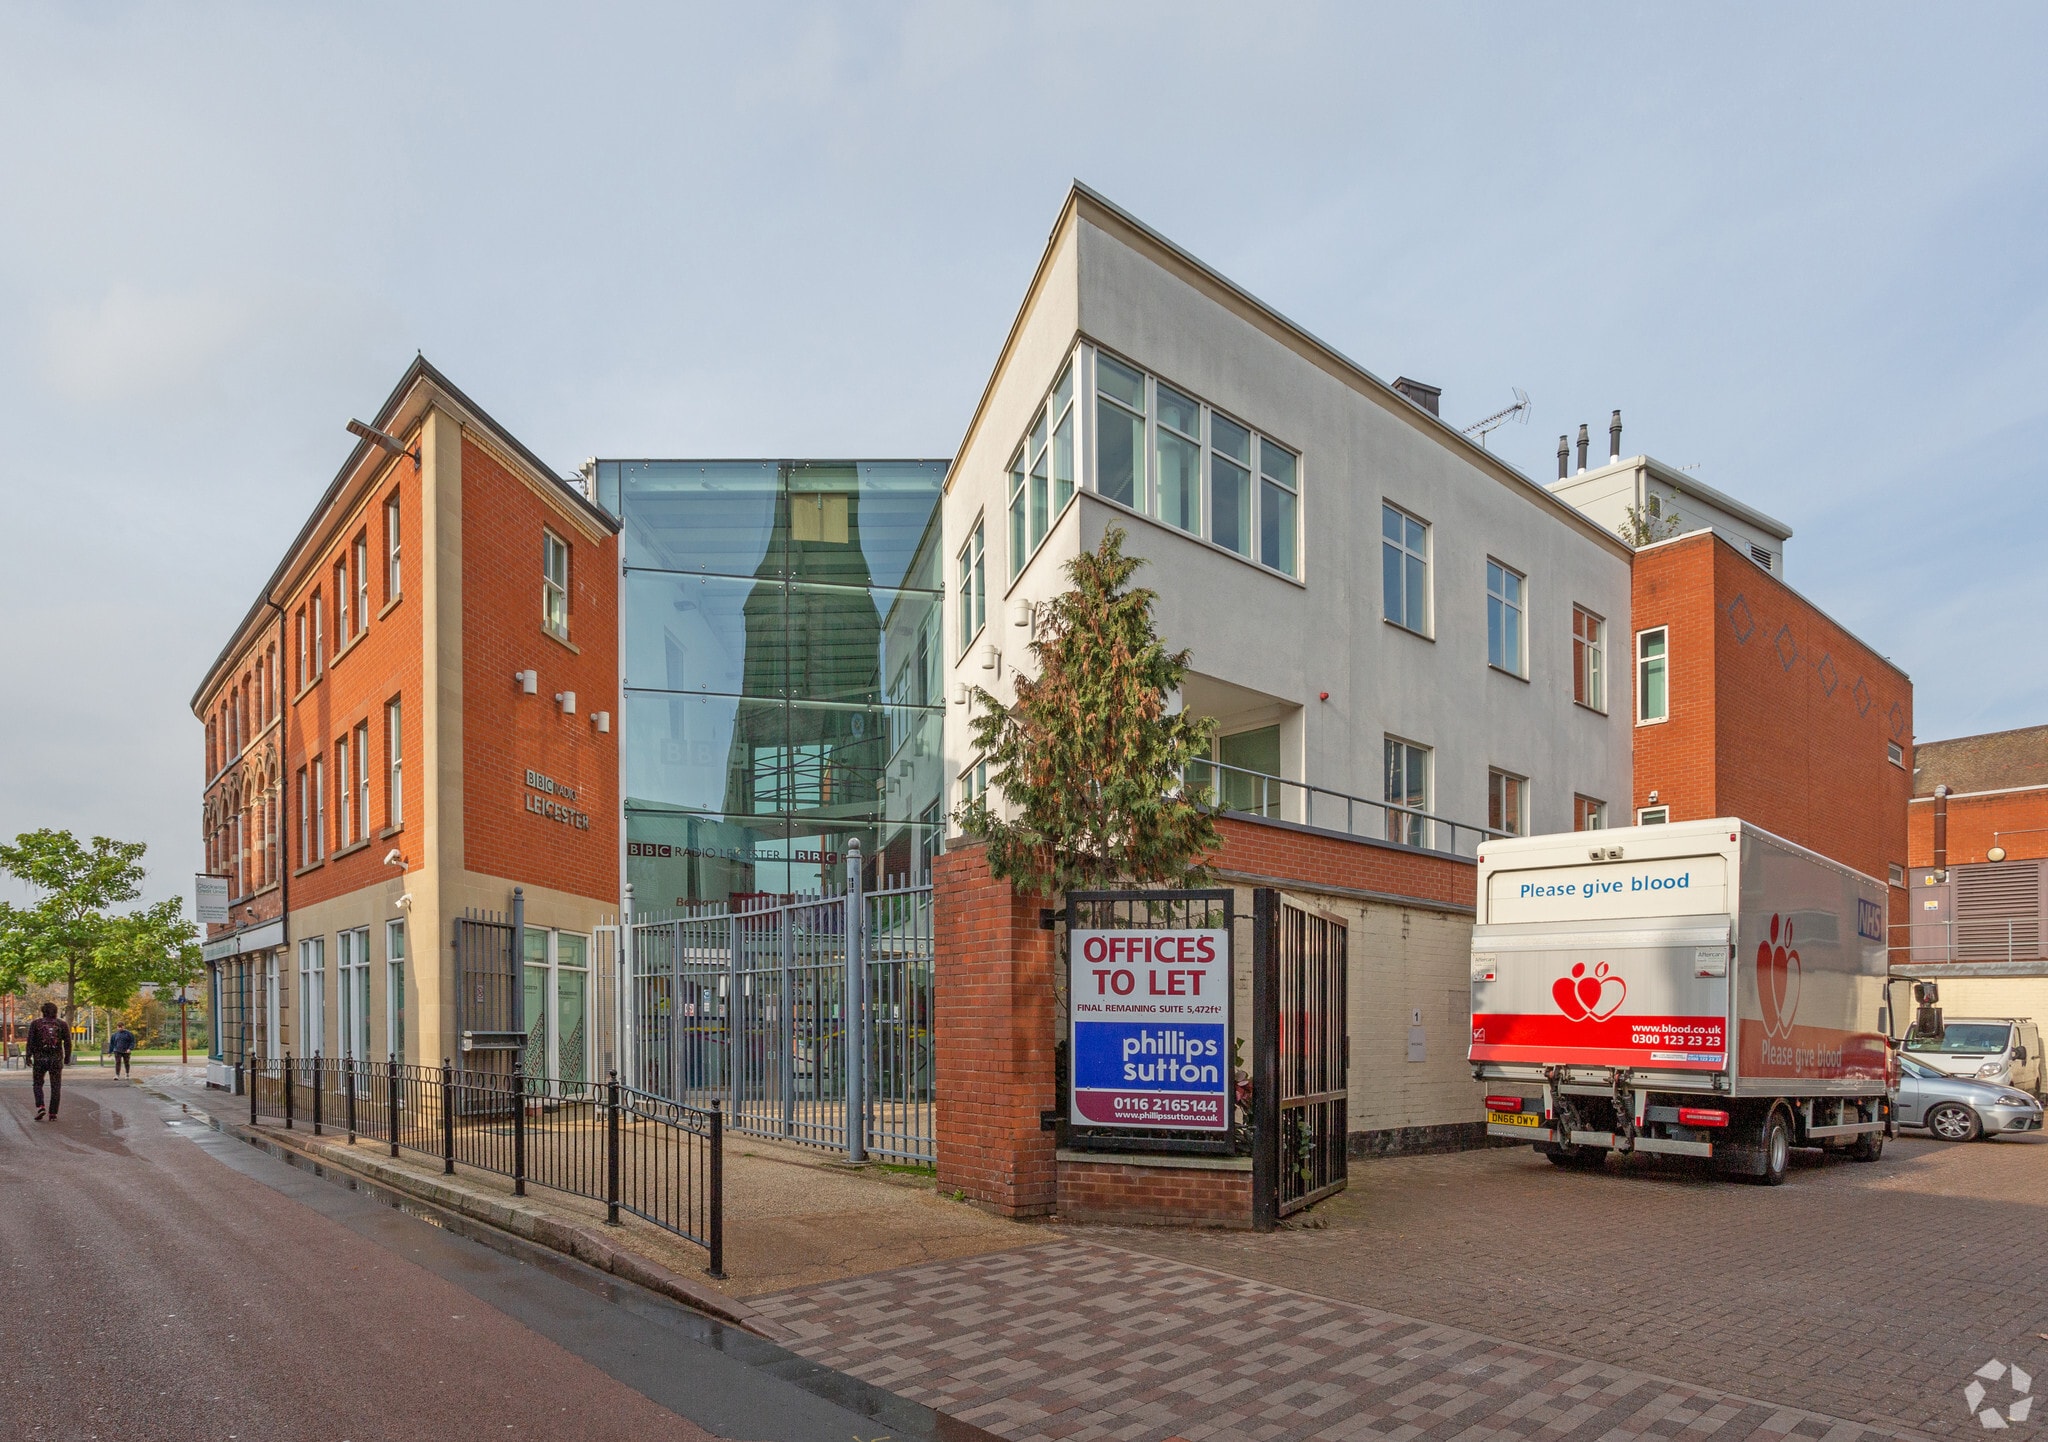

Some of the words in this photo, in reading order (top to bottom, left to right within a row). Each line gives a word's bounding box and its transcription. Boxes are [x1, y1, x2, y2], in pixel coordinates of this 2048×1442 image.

[526, 769, 554, 795] BBC
[525, 793, 590, 831] LEICESTER
[627, 843, 671, 858] BBC
[675, 846, 716, 859] RADIO
[720, 848, 780, 860] LEICESTER
[796, 850, 838, 865] BBC
[1520, 883, 1576, 898] Please
[1583, 879, 1624, 899] give
[1631, 872, 1690, 892] blood
[1859, 900, 1881, 940] NHS
[1083, 936, 1216, 963] OFFICES
[1092, 969, 1136, 995] TO
[1149, 969, 1206, 995] LET
[1077, 1004, 1103, 1012] FINAL
[1105, 1004, 1157, 1013] REMAINING
[1159, 1005, 1184, 1013] SUITE
[1631, 1024, 1721, 1034] www.blood.co.uk
[1631, 1034, 1660, 1045] 0300
[1664, 1035, 1685, 1046] 123
[1687, 1036, 1703, 1046] 23
[1705, 1036, 1721, 1047] 23
[1123, 1030, 1218, 1063] phillips
[1761, 1039, 1793, 1066] Please
[1795, 1041, 1815, 1074] give
[1817, 1042, 1842, 1068] blood
[1123, 1058, 1218, 1083] sutton
[1113, 1097, 1149, 1110] 0116
[1153, 1098, 1218, 1113] 2165144
[1115, 1111, 1218, 1122] www.phillipssutton.co.uk
[1492, 1113, 1515, 1124] DN66
[1516, 1115, 1535, 1126] OWY
